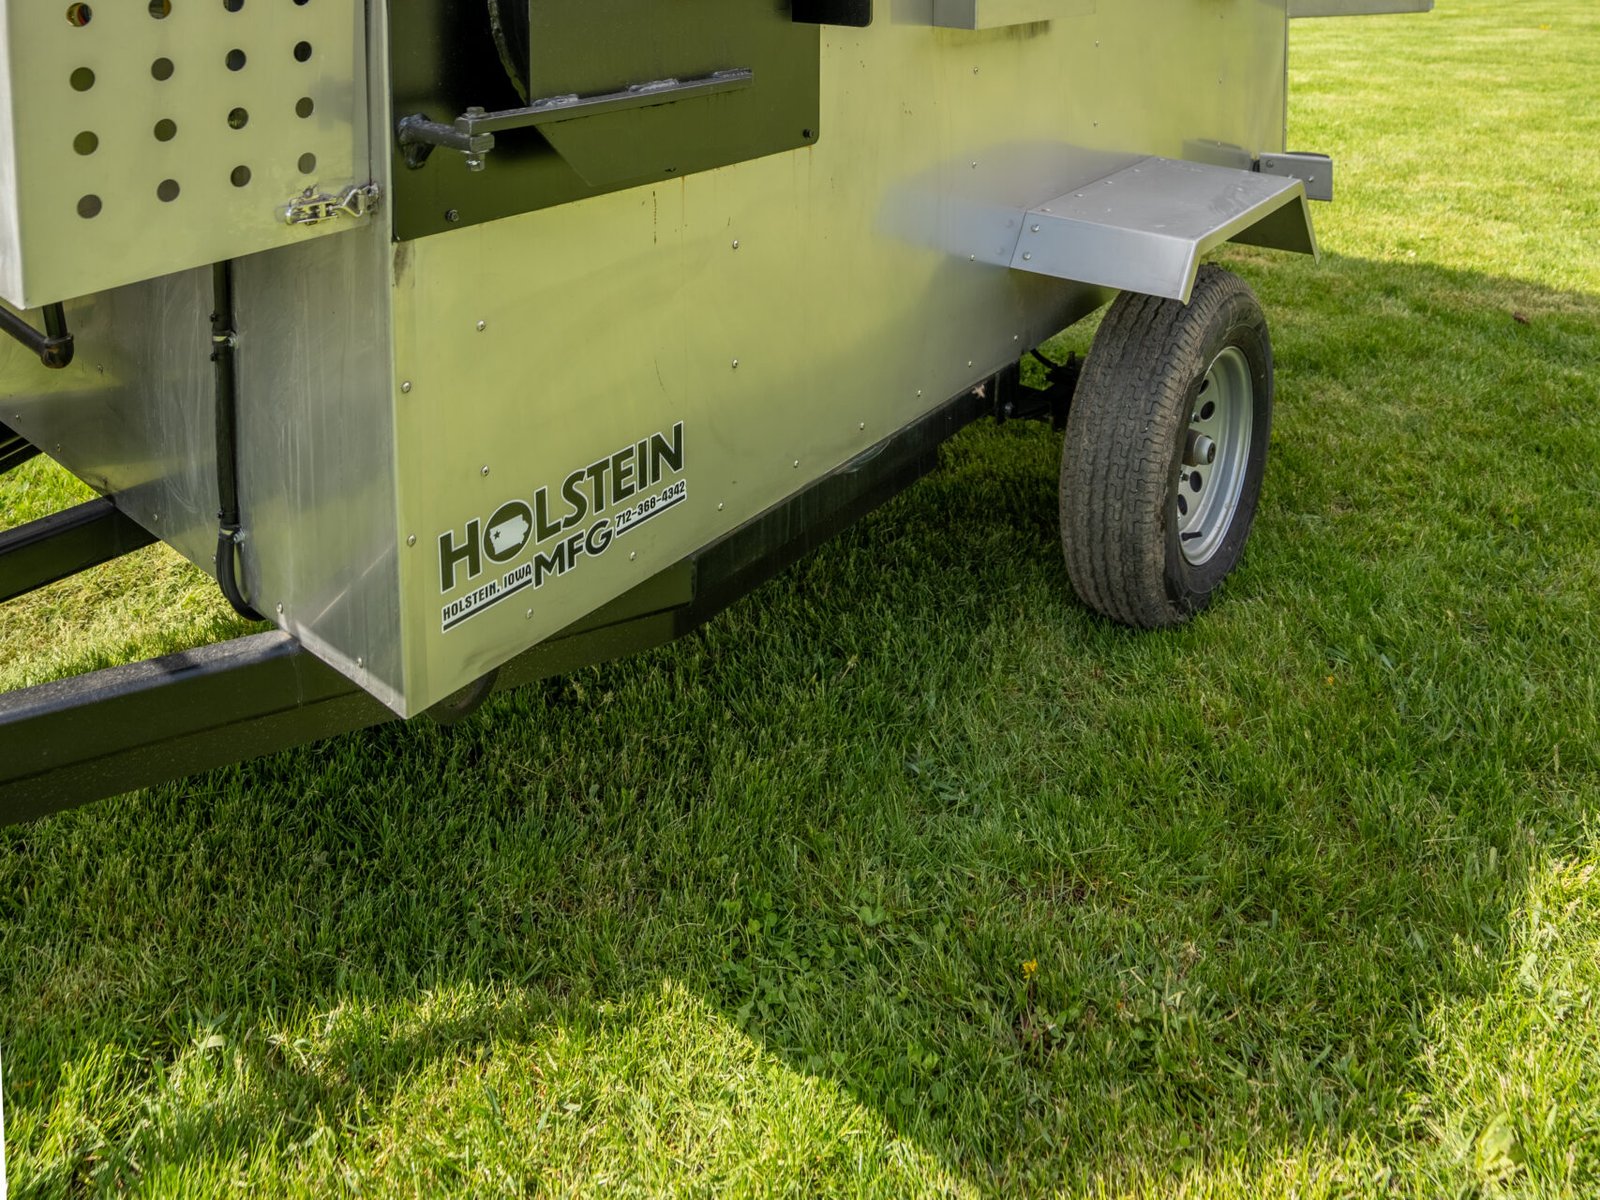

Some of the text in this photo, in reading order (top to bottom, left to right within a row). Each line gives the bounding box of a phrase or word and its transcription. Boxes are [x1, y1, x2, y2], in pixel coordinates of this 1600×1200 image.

[439, 421, 683, 593] HOLSTEIN
[615, 481, 685, 528] 712-368-4342
[504, 564, 532, 588] IOWA
[534, 520, 613, 588] MFG
